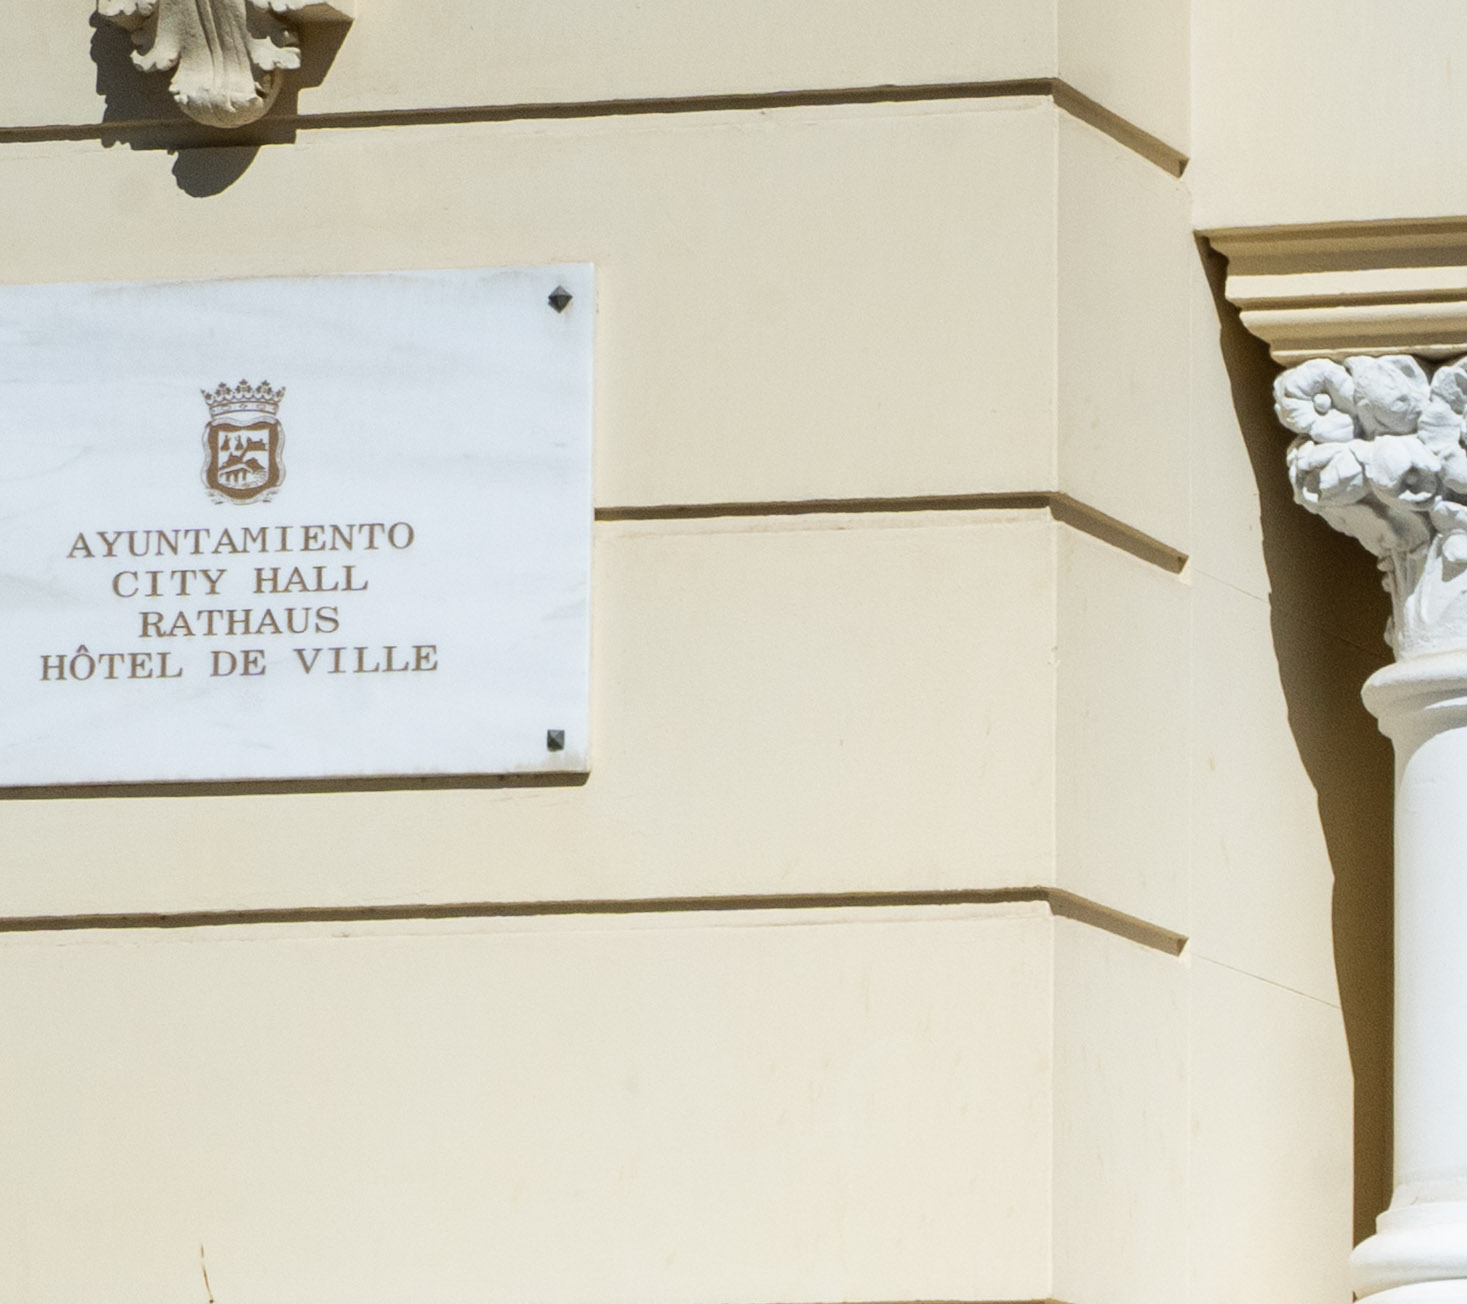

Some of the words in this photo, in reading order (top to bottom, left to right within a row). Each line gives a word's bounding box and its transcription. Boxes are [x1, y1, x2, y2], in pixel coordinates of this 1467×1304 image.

[66, 521, 416, 559] AYUNTAMIENTO
[111, 568, 228, 599] CITY
[252, 565, 369, 595] HALL
[138, 606, 341, 639] RATHAUS
[40, 644, 184, 682] HÔTEL
[209, 649, 267, 677] DE
[292, 644, 438, 676] VILLE
